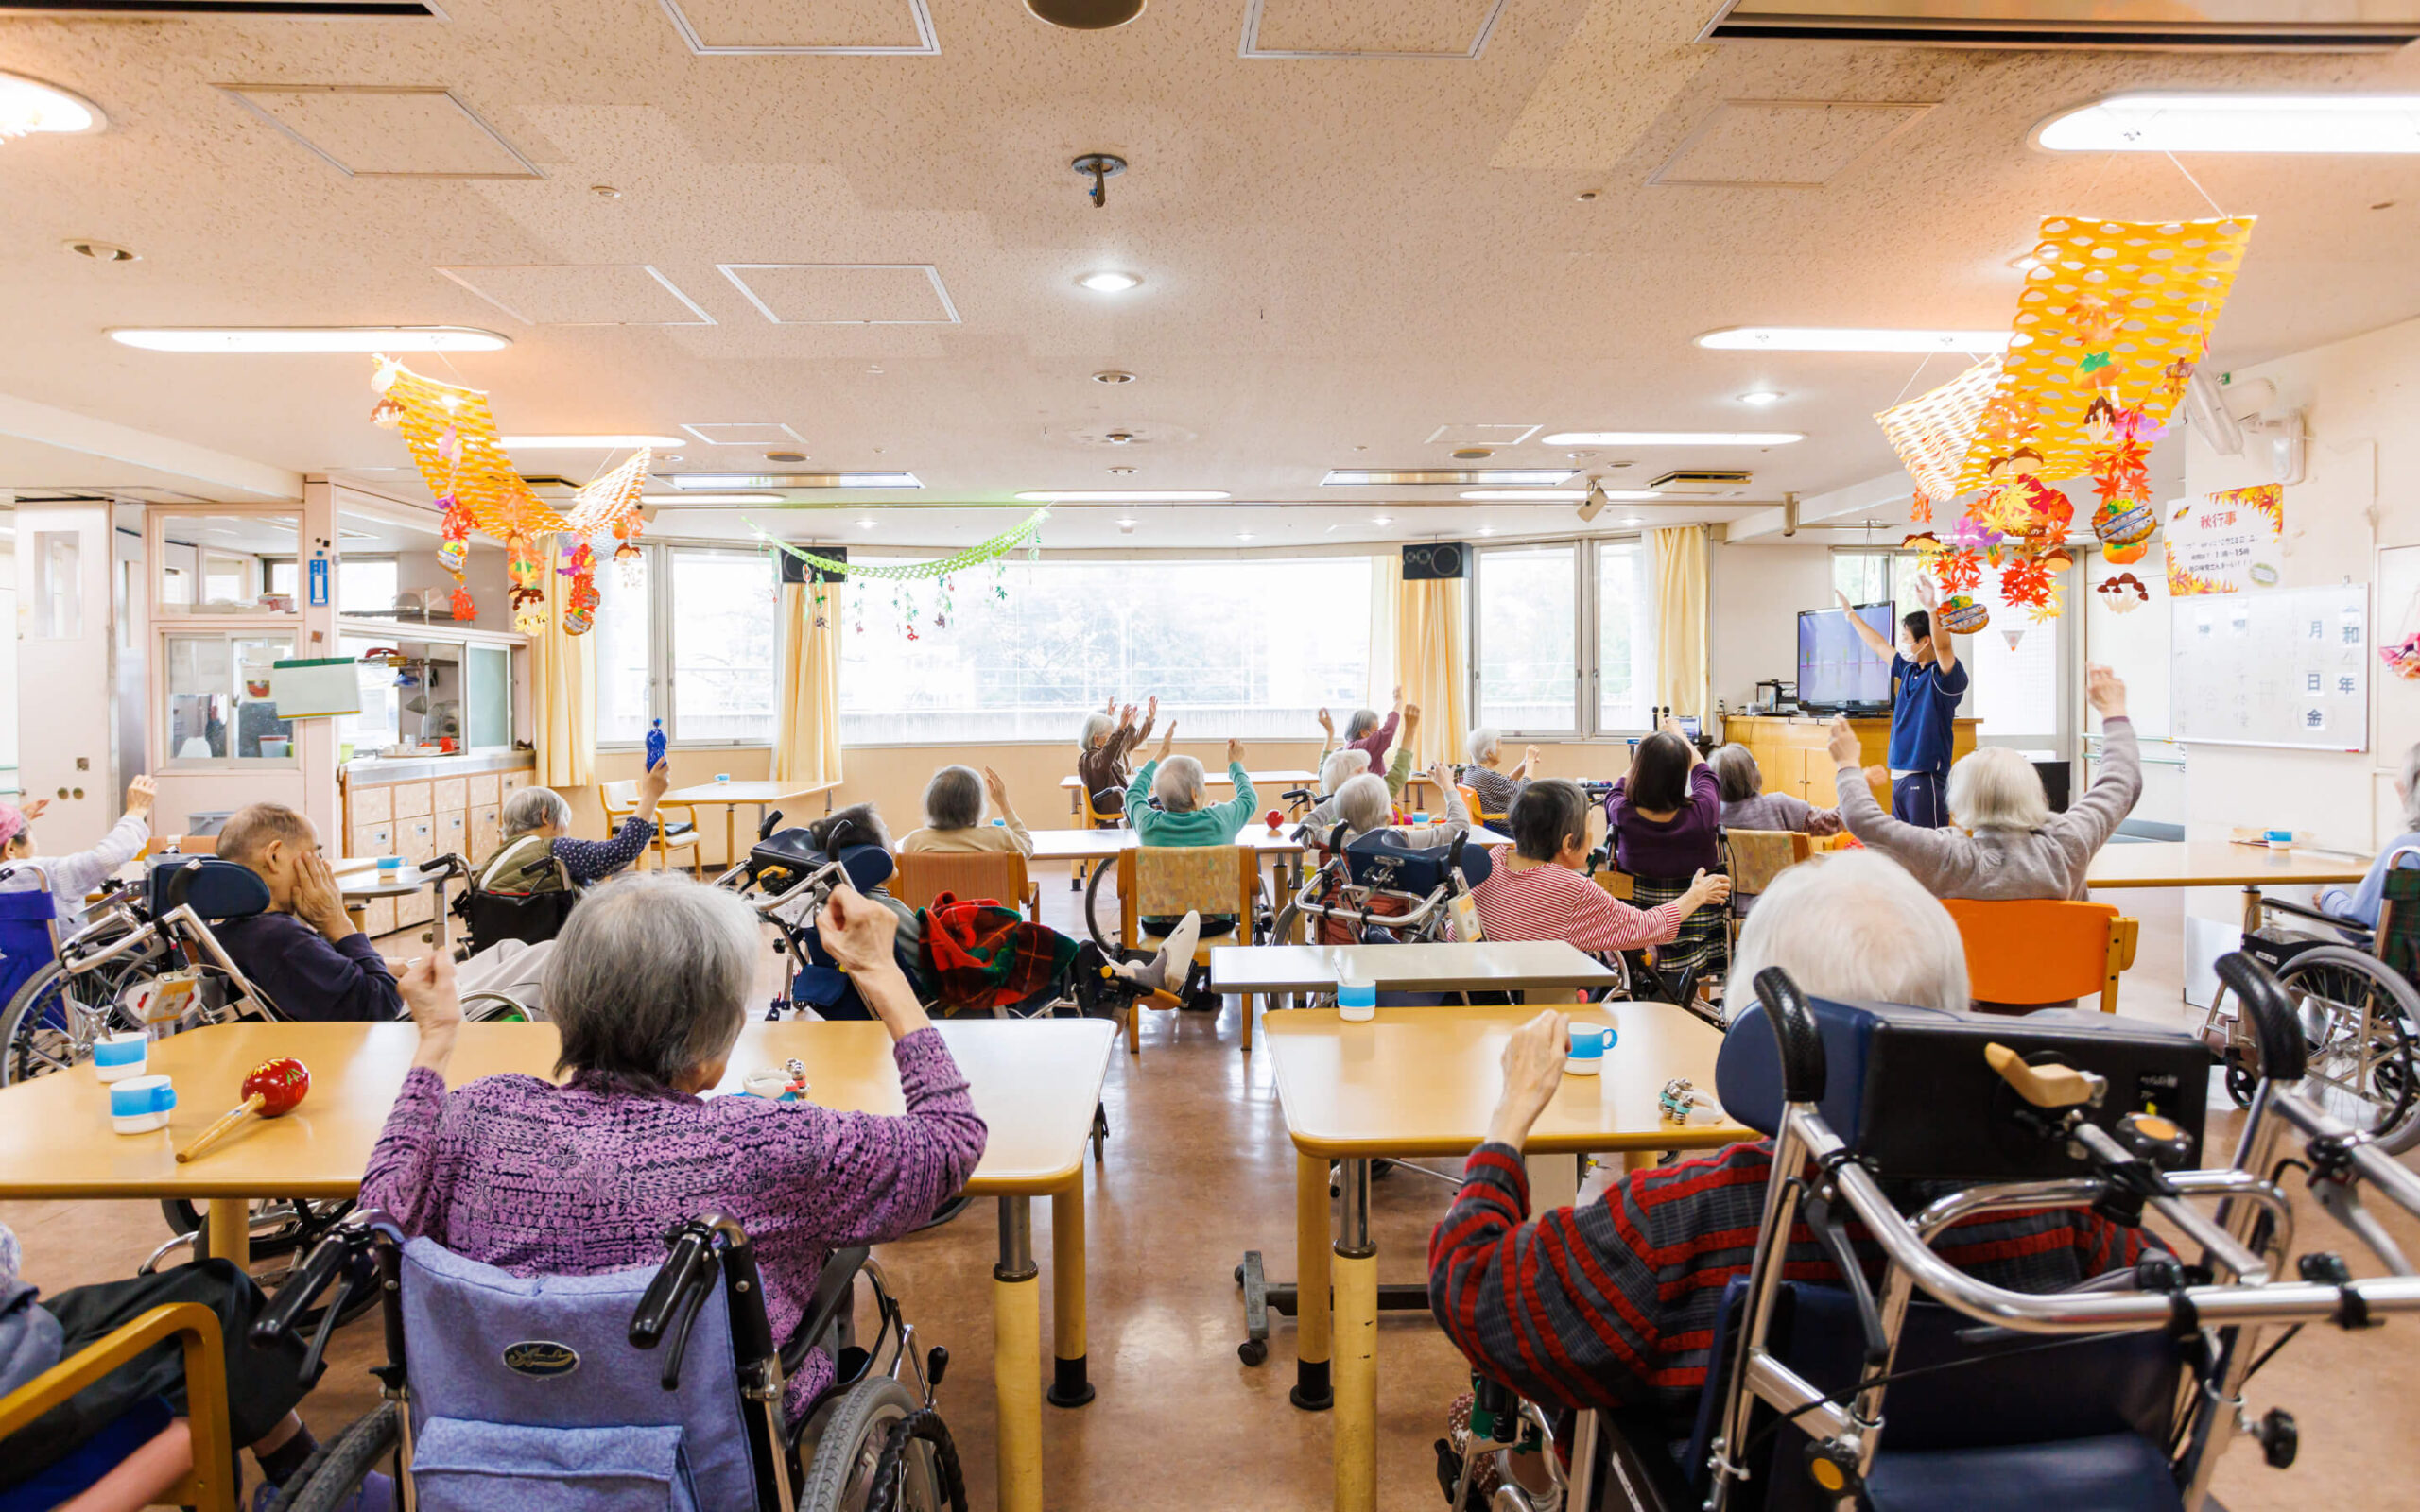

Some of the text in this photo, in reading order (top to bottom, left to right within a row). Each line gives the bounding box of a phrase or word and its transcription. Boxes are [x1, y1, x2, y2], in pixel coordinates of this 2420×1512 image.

[2200, 510, 2237, 529] 秋行事
[2307, 620, 2323, 727] 月 日 金
[2338, 676, 2356, 695] 年
